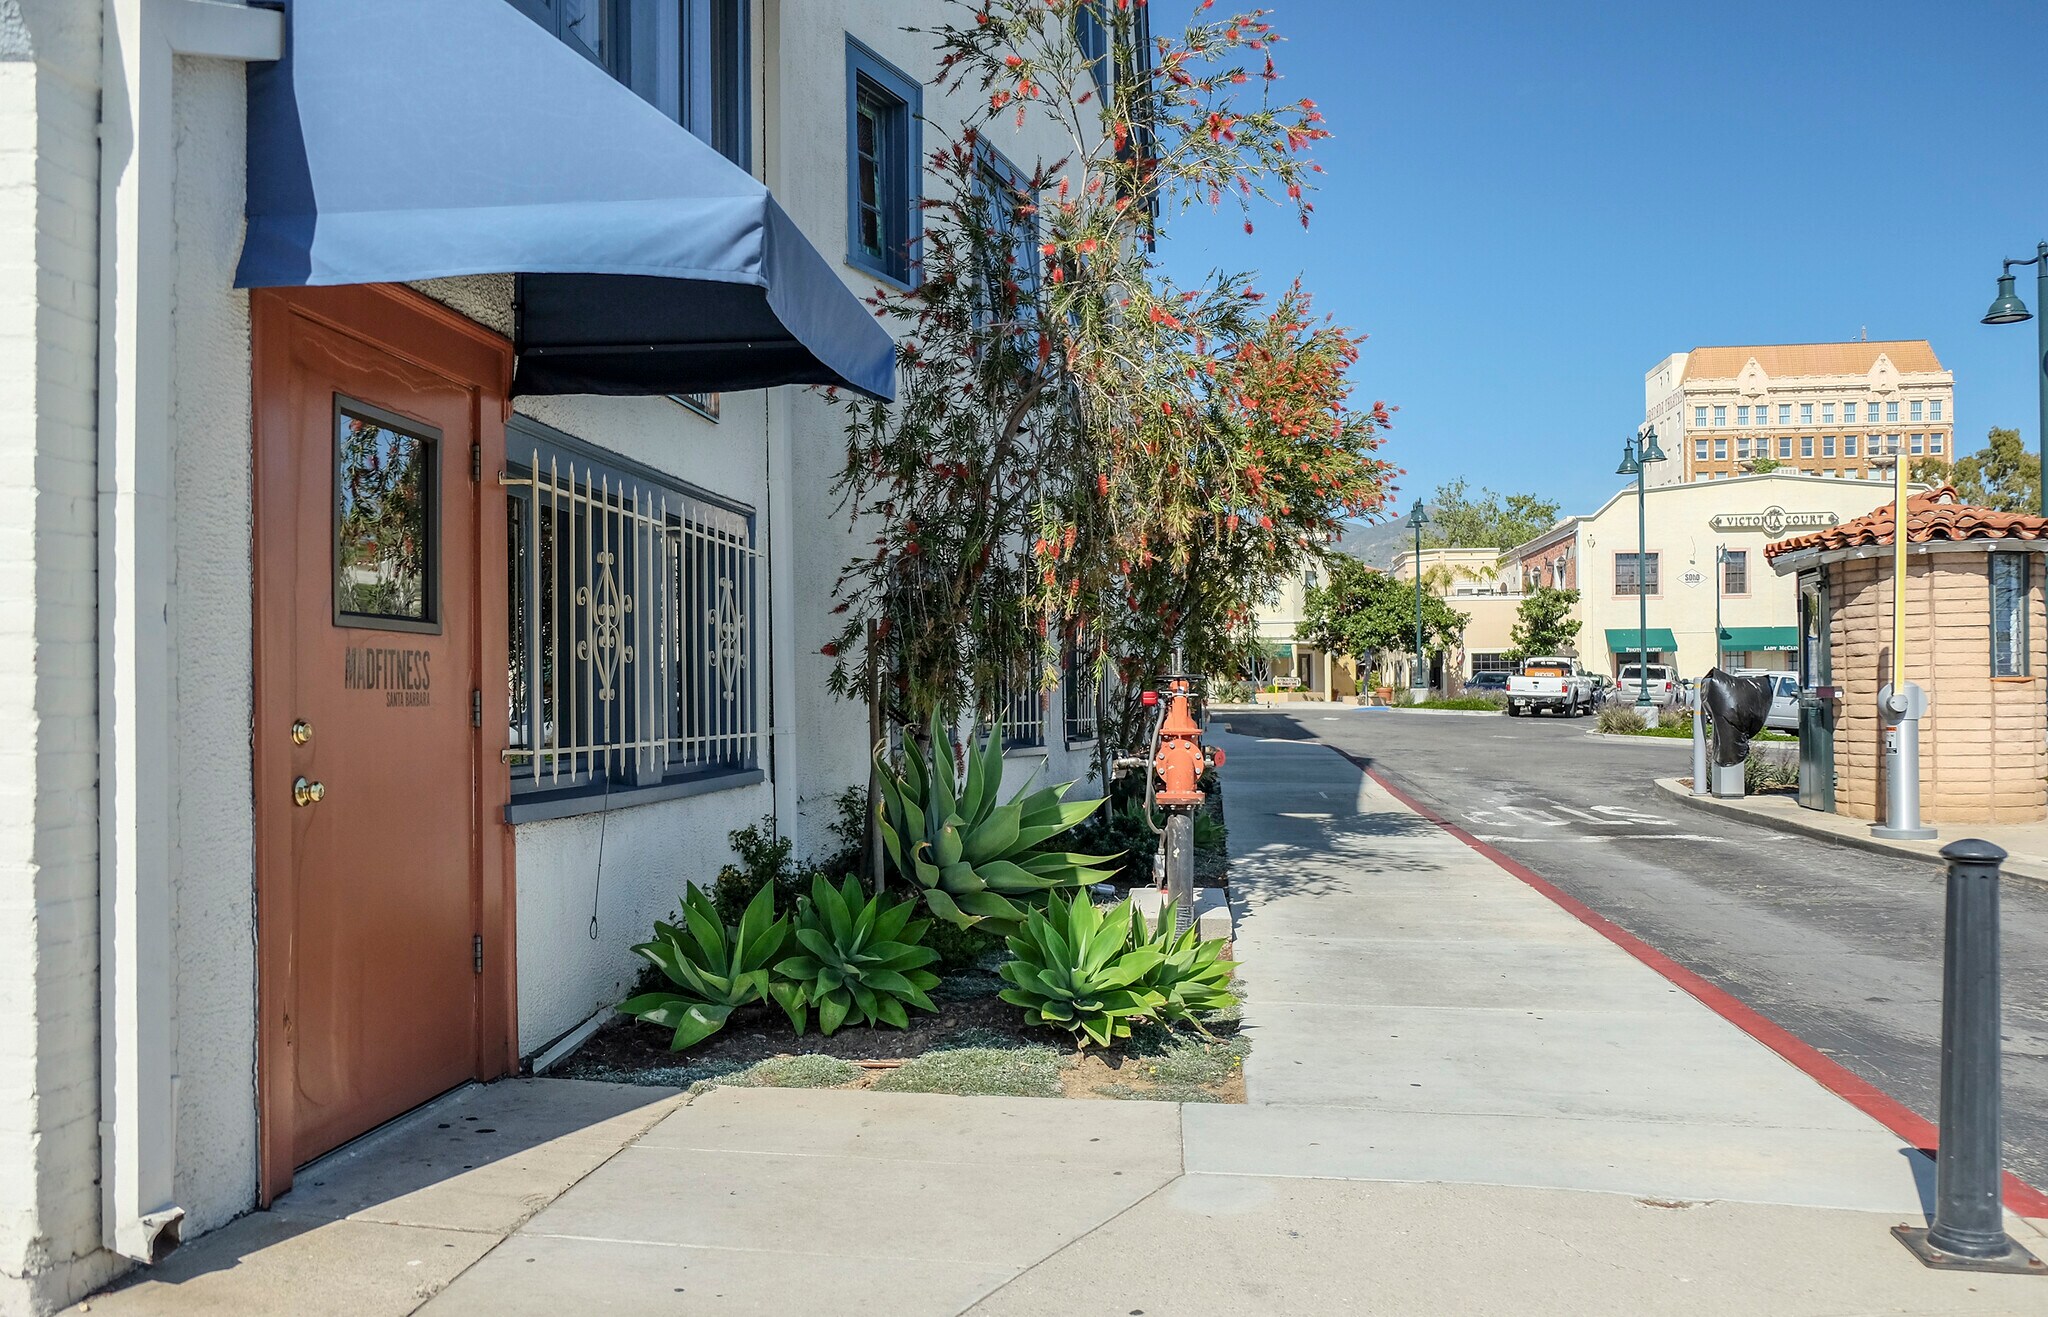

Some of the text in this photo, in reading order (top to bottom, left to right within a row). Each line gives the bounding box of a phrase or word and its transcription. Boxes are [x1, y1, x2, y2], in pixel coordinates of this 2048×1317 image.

[1726, 515, 1824, 526] VICTORIA COURT
[345, 646, 430, 690] MADFITNESS
[386, 692, 430, 707] SANTA BARBARA
